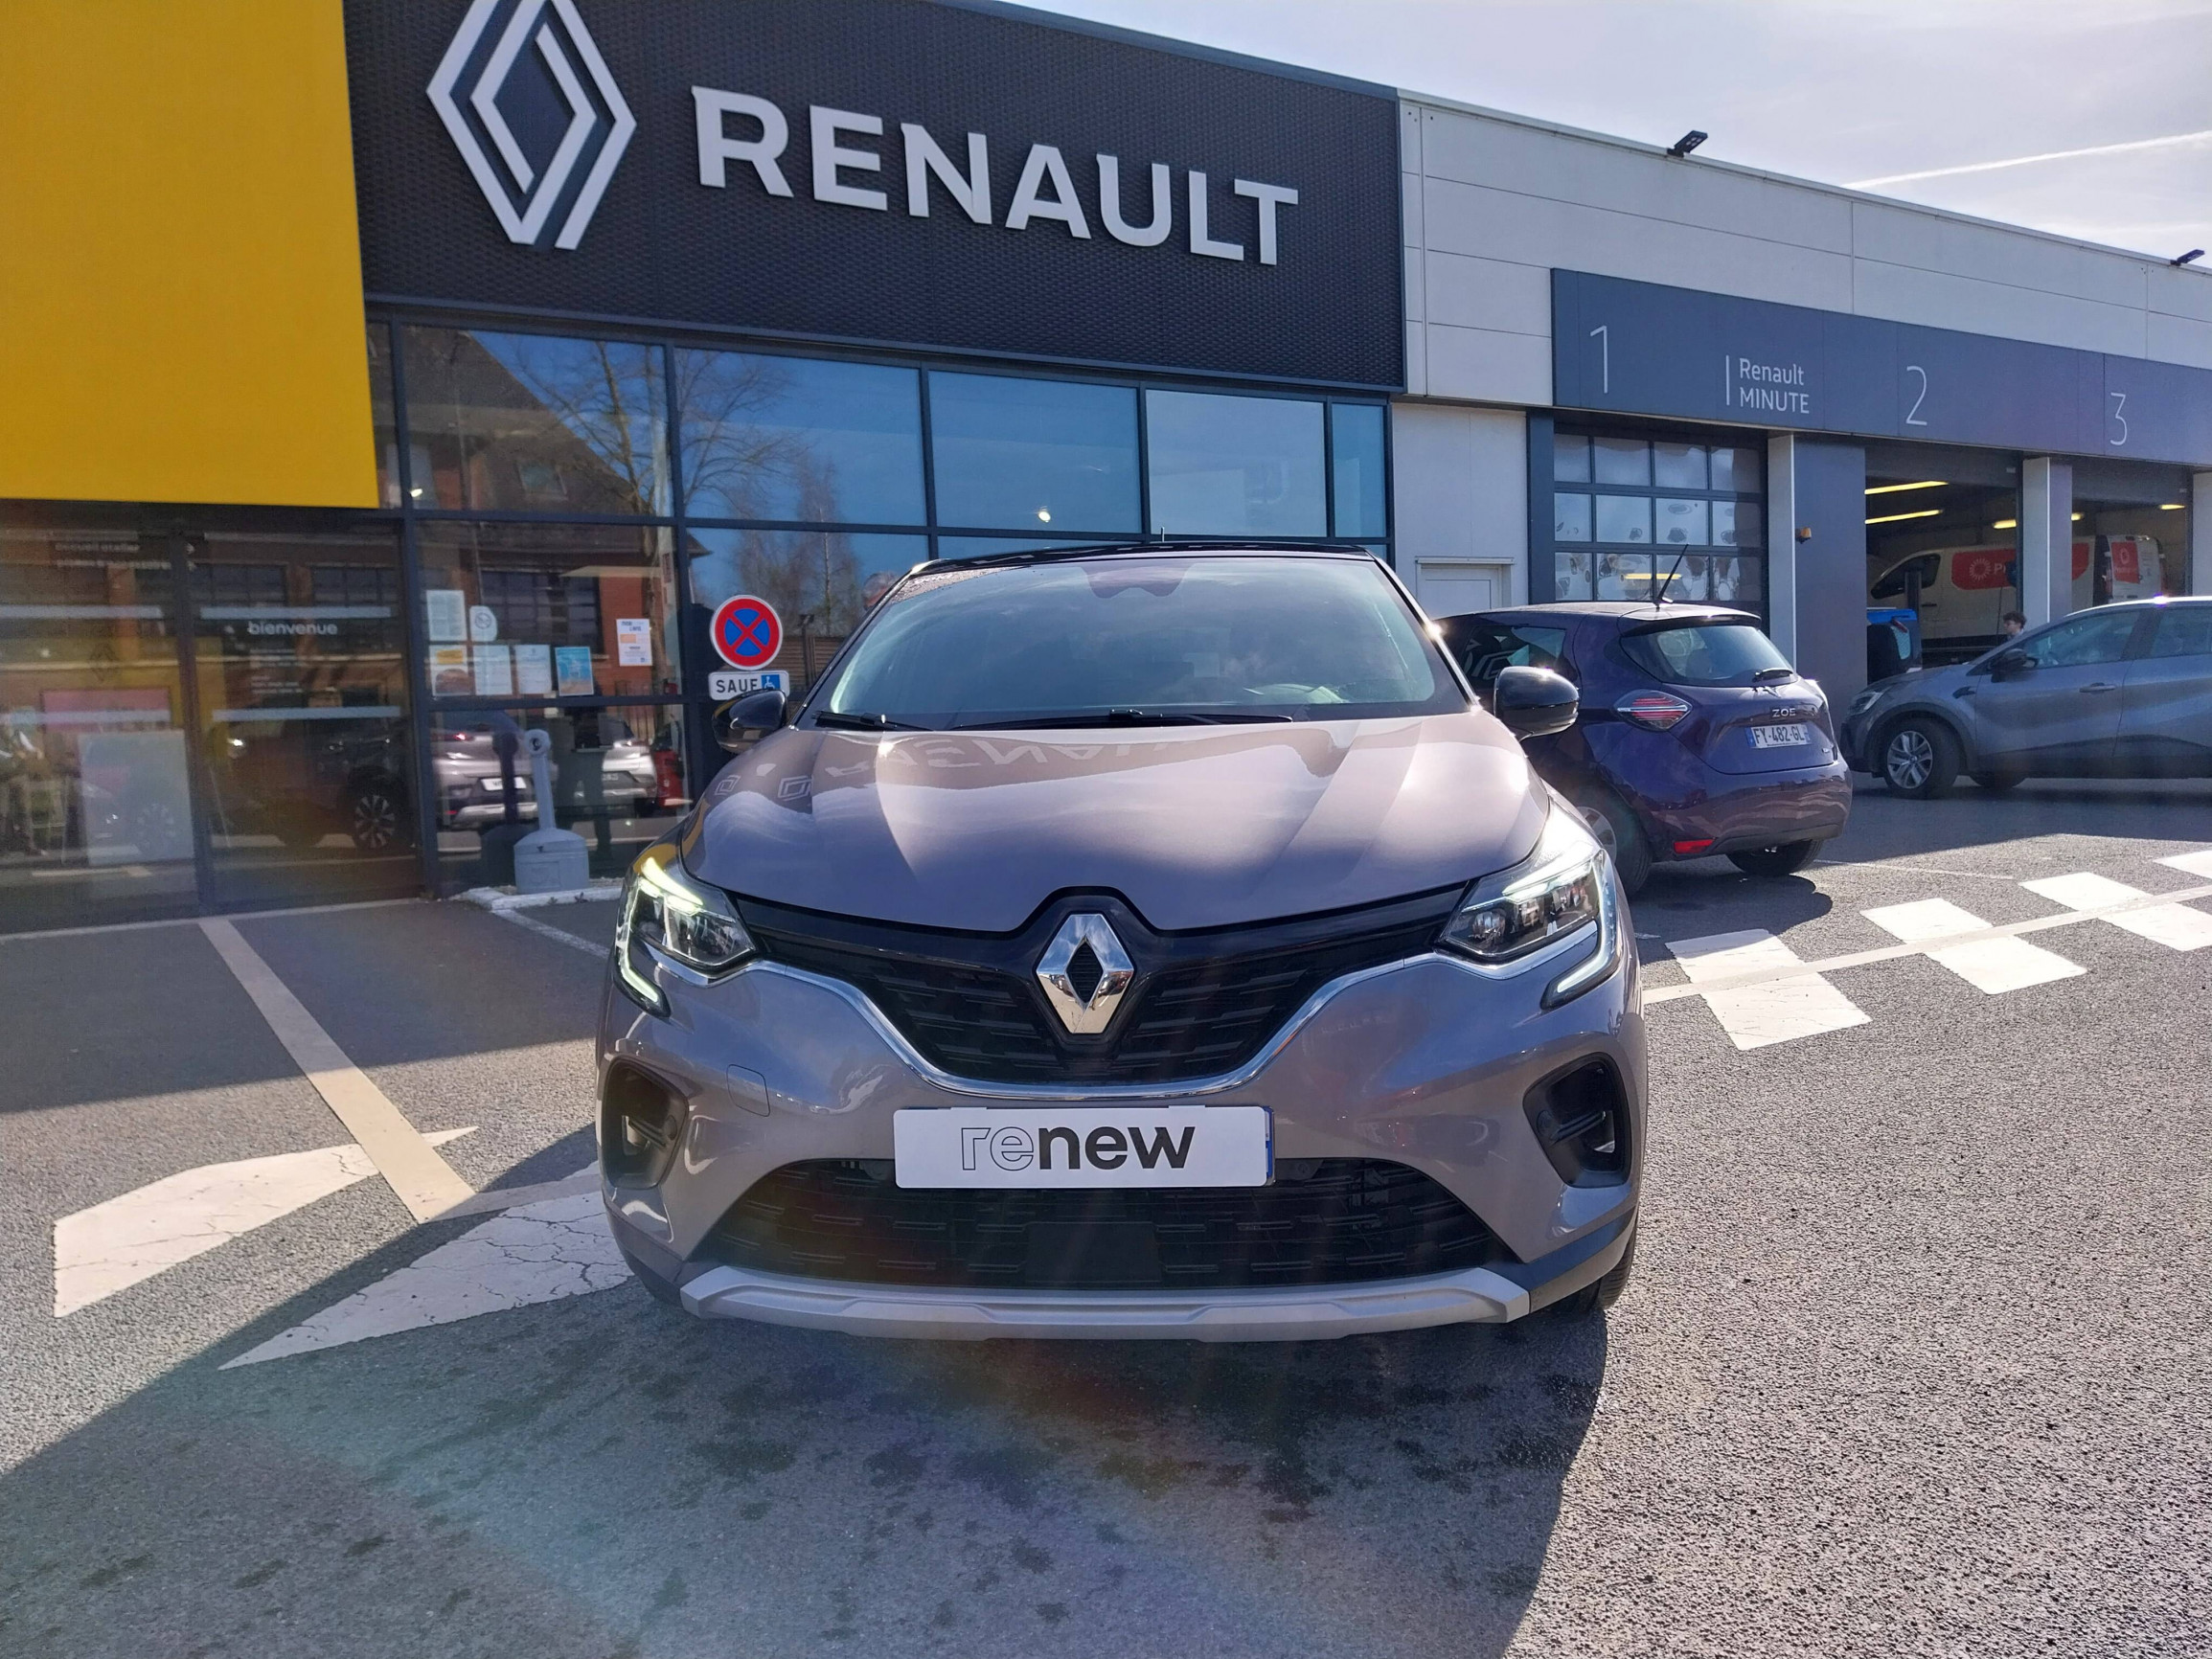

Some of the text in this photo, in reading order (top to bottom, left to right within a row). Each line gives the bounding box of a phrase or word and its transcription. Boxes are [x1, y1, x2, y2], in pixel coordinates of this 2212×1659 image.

[691, 84, 1299, 266] RENAULT
[1589, 325, 1608, 394] 1
[1739, 357, 1805, 386] Renault
[1739, 386, 1810, 415] MINUTE
[1905, 365, 1927, 425] 2
[2110, 392, 2127, 446] 3
[247, 620, 338, 635] bienvenue
[716, 678, 758, 693] SAUF
[1771, 707, 1796, 718] ZOE
[1753, 725, 1805, 744] FY-482-GL
[961, 1125, 1196, 1171] renew
